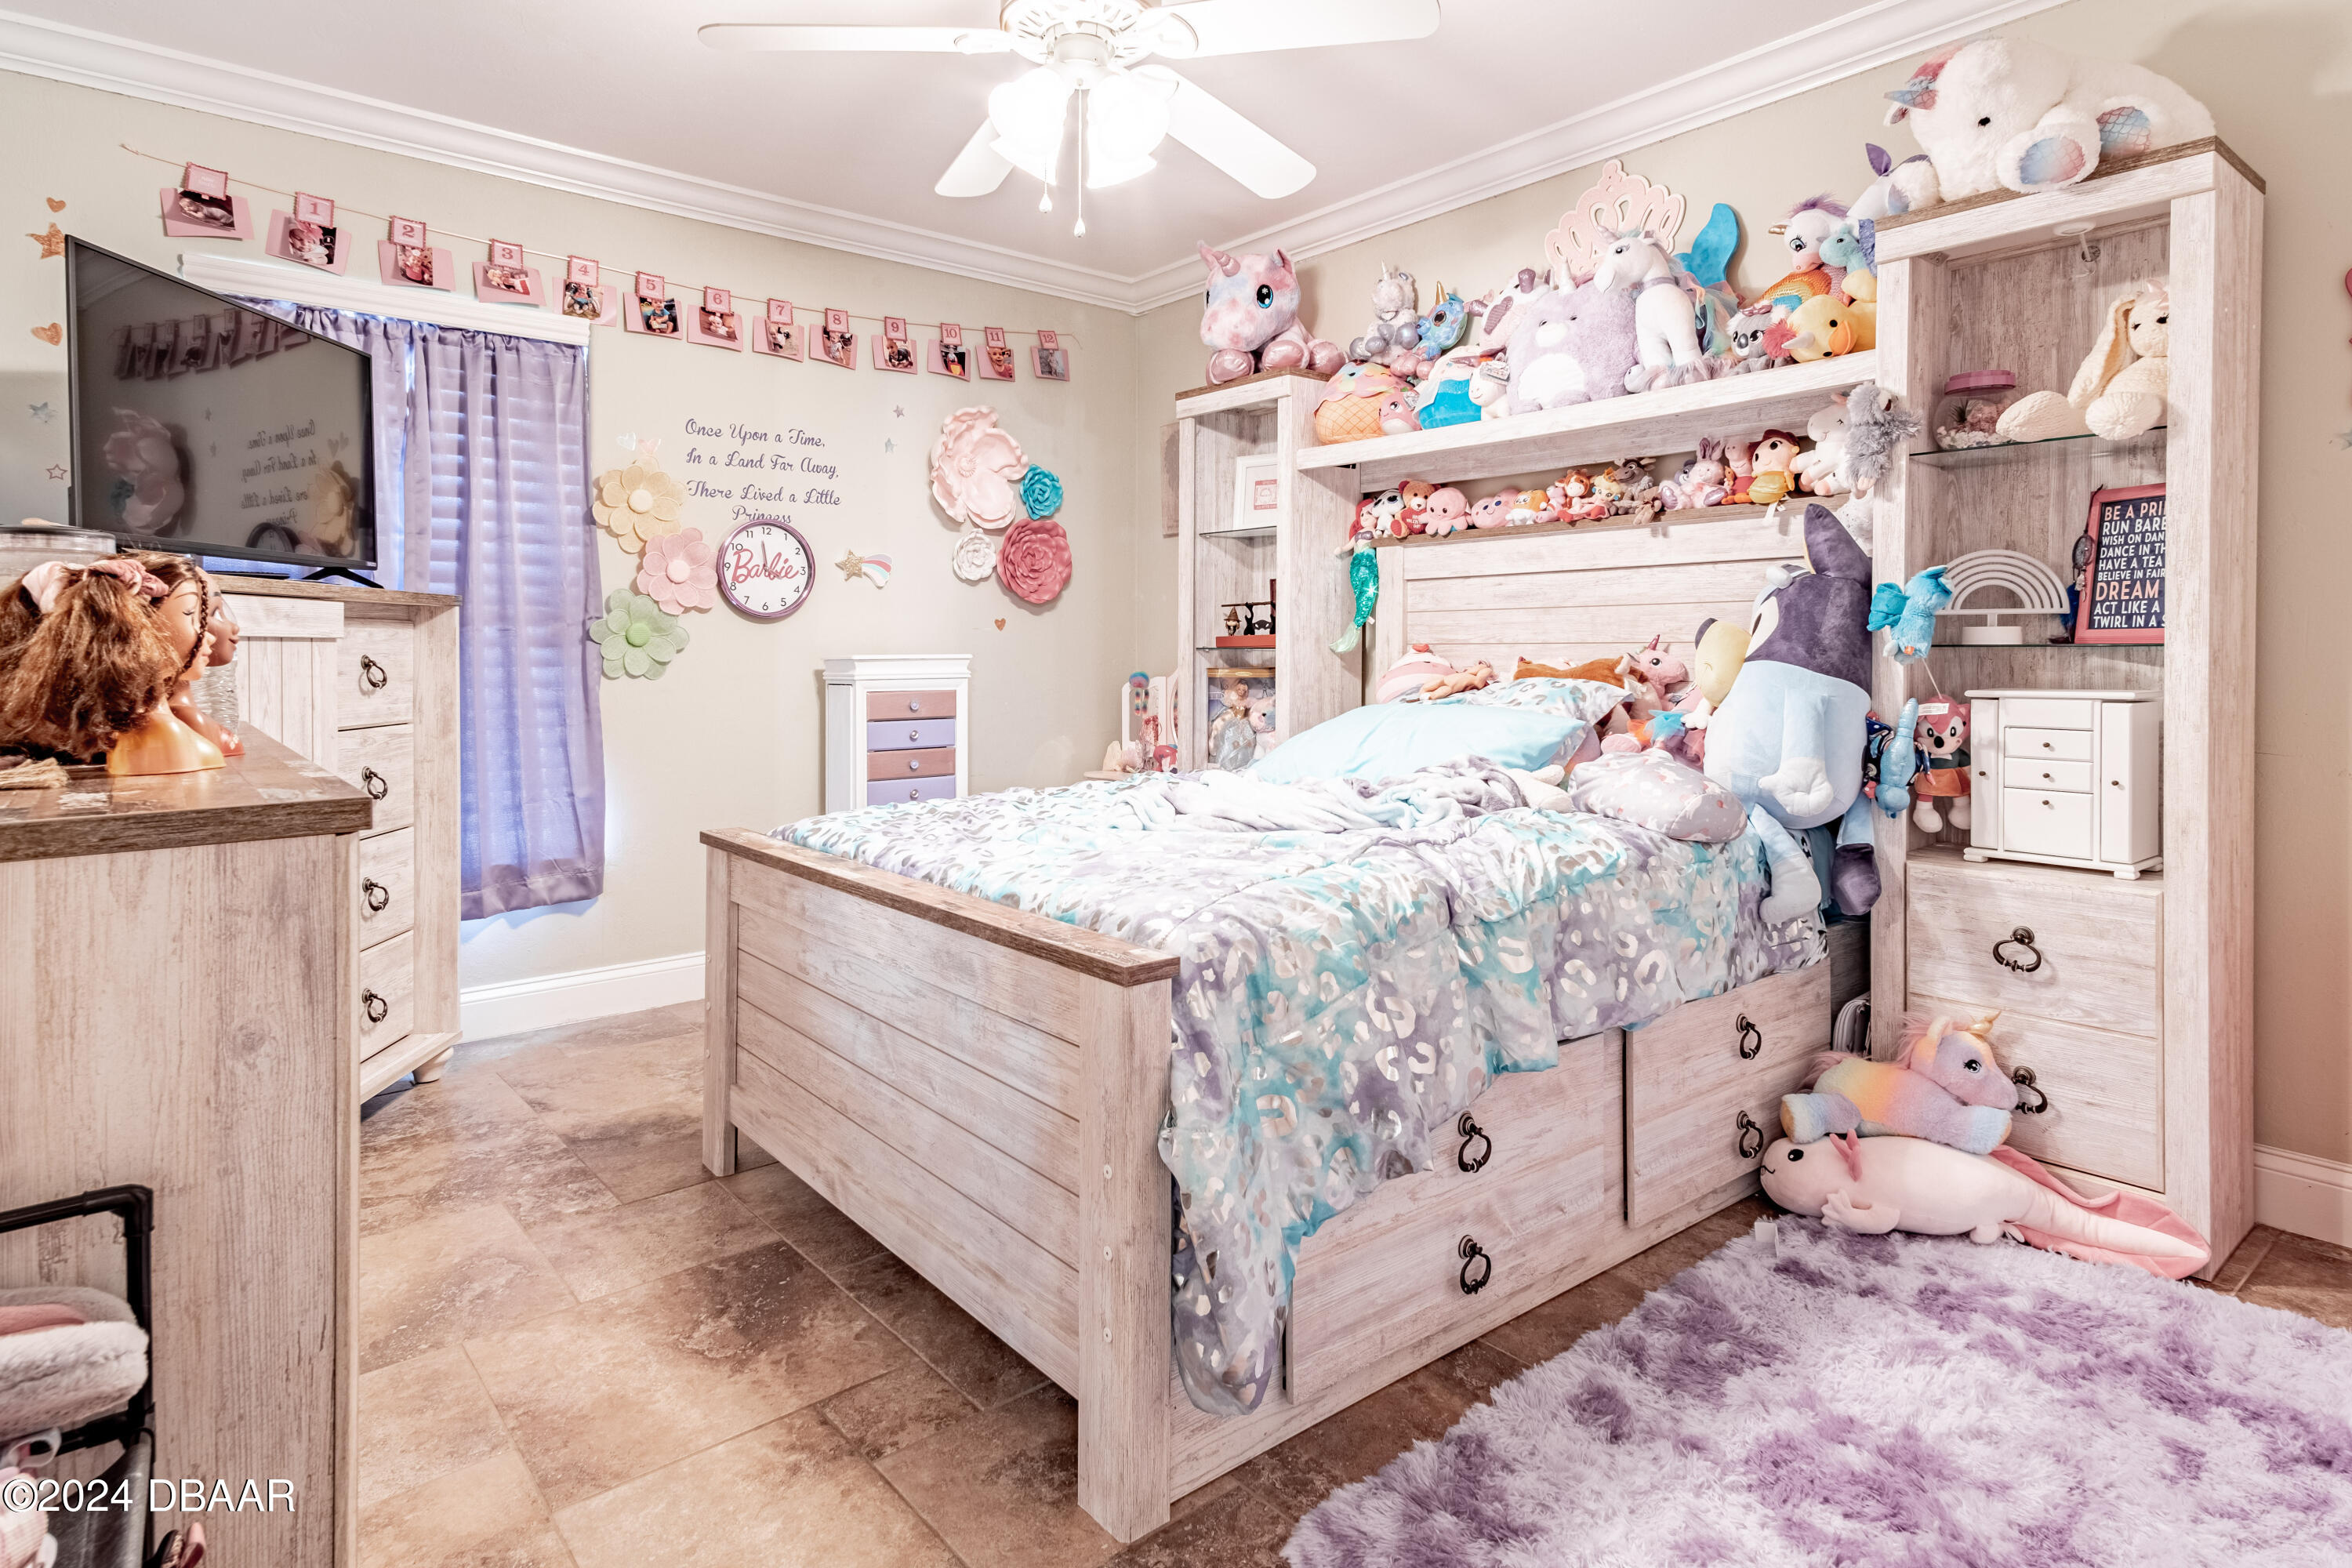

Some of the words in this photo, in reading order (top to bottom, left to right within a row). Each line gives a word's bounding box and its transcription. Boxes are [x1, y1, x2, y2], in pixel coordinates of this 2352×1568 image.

[310, 202, 320, 216] 1
[402, 224, 414, 238] 2
[501, 247, 514, 259] 3
[578, 263, 590, 275] 4
[646, 278, 655, 290] 5
[713, 293, 723, 305] 6
[776, 305, 785, 315] 7
[833, 314, 842, 325] 8
[891, 322, 899, 332] 9
[944, 328, 957, 338] 10
[989, 332, 1001, 342] 11
[1043, 334, 1054, 343] 12
[685, 418, 722, 437] Once
[729, 423, 768, 446] Upon
[775, 433, 782, 443] a
[788, 428, 826, 448] Time,
[685, 447, 702, 464] In
[709, 456, 717, 466] a
[724, 451, 764, 470] Land
[771, 454, 793, 471] Far
[800, 456, 839, 480] Away,
[686, 480, 734, 499] There
[740, 484, 784, 502] Lived
[789, 493, 797, 503] a
[804, 488, 842, 506] Little
[2104, 505, 2122, 521] BE
[2125, 504, 2135, 519] A
[2140, 501, 2165, 517] PRI
[2103, 520, 2130, 535] RUN
[2102, 535, 2125, 546] WISH
[2127, 534, 2142, 544] ON
[2100, 545, 2136, 559] DANCE
[2139, 544, 2151, 556] IN
[724, 562, 731, 571] 9
[731, 549, 799, 583] Barbie
[2099, 557, 2127, 571] HAVE
[2130, 558, 2138, 568] A
[2143, 556, 2162, 568] TEA
[800, 566, 806, 575] 3
[2098, 570, 2132, 581] BELIEVE
[2133, 569, 2143, 579] IN
[730, 582, 737, 591] 8
[793, 586, 800, 594] 4
[2096, 579, 2160, 601] DREAM
[744, 596, 750, 605] 7
[762, 602, 768, 611] 6
[781, 597, 787, 607] 5
[2093, 601, 2118, 615] ACT
[2122, 601, 2148, 614] LIKE
[2151, 600, 2161, 613] A
[2093, 615, 2129, 629] TWIRL
[2132, 614, 2145, 627] IN
[2148, 614, 2157, 627] A
